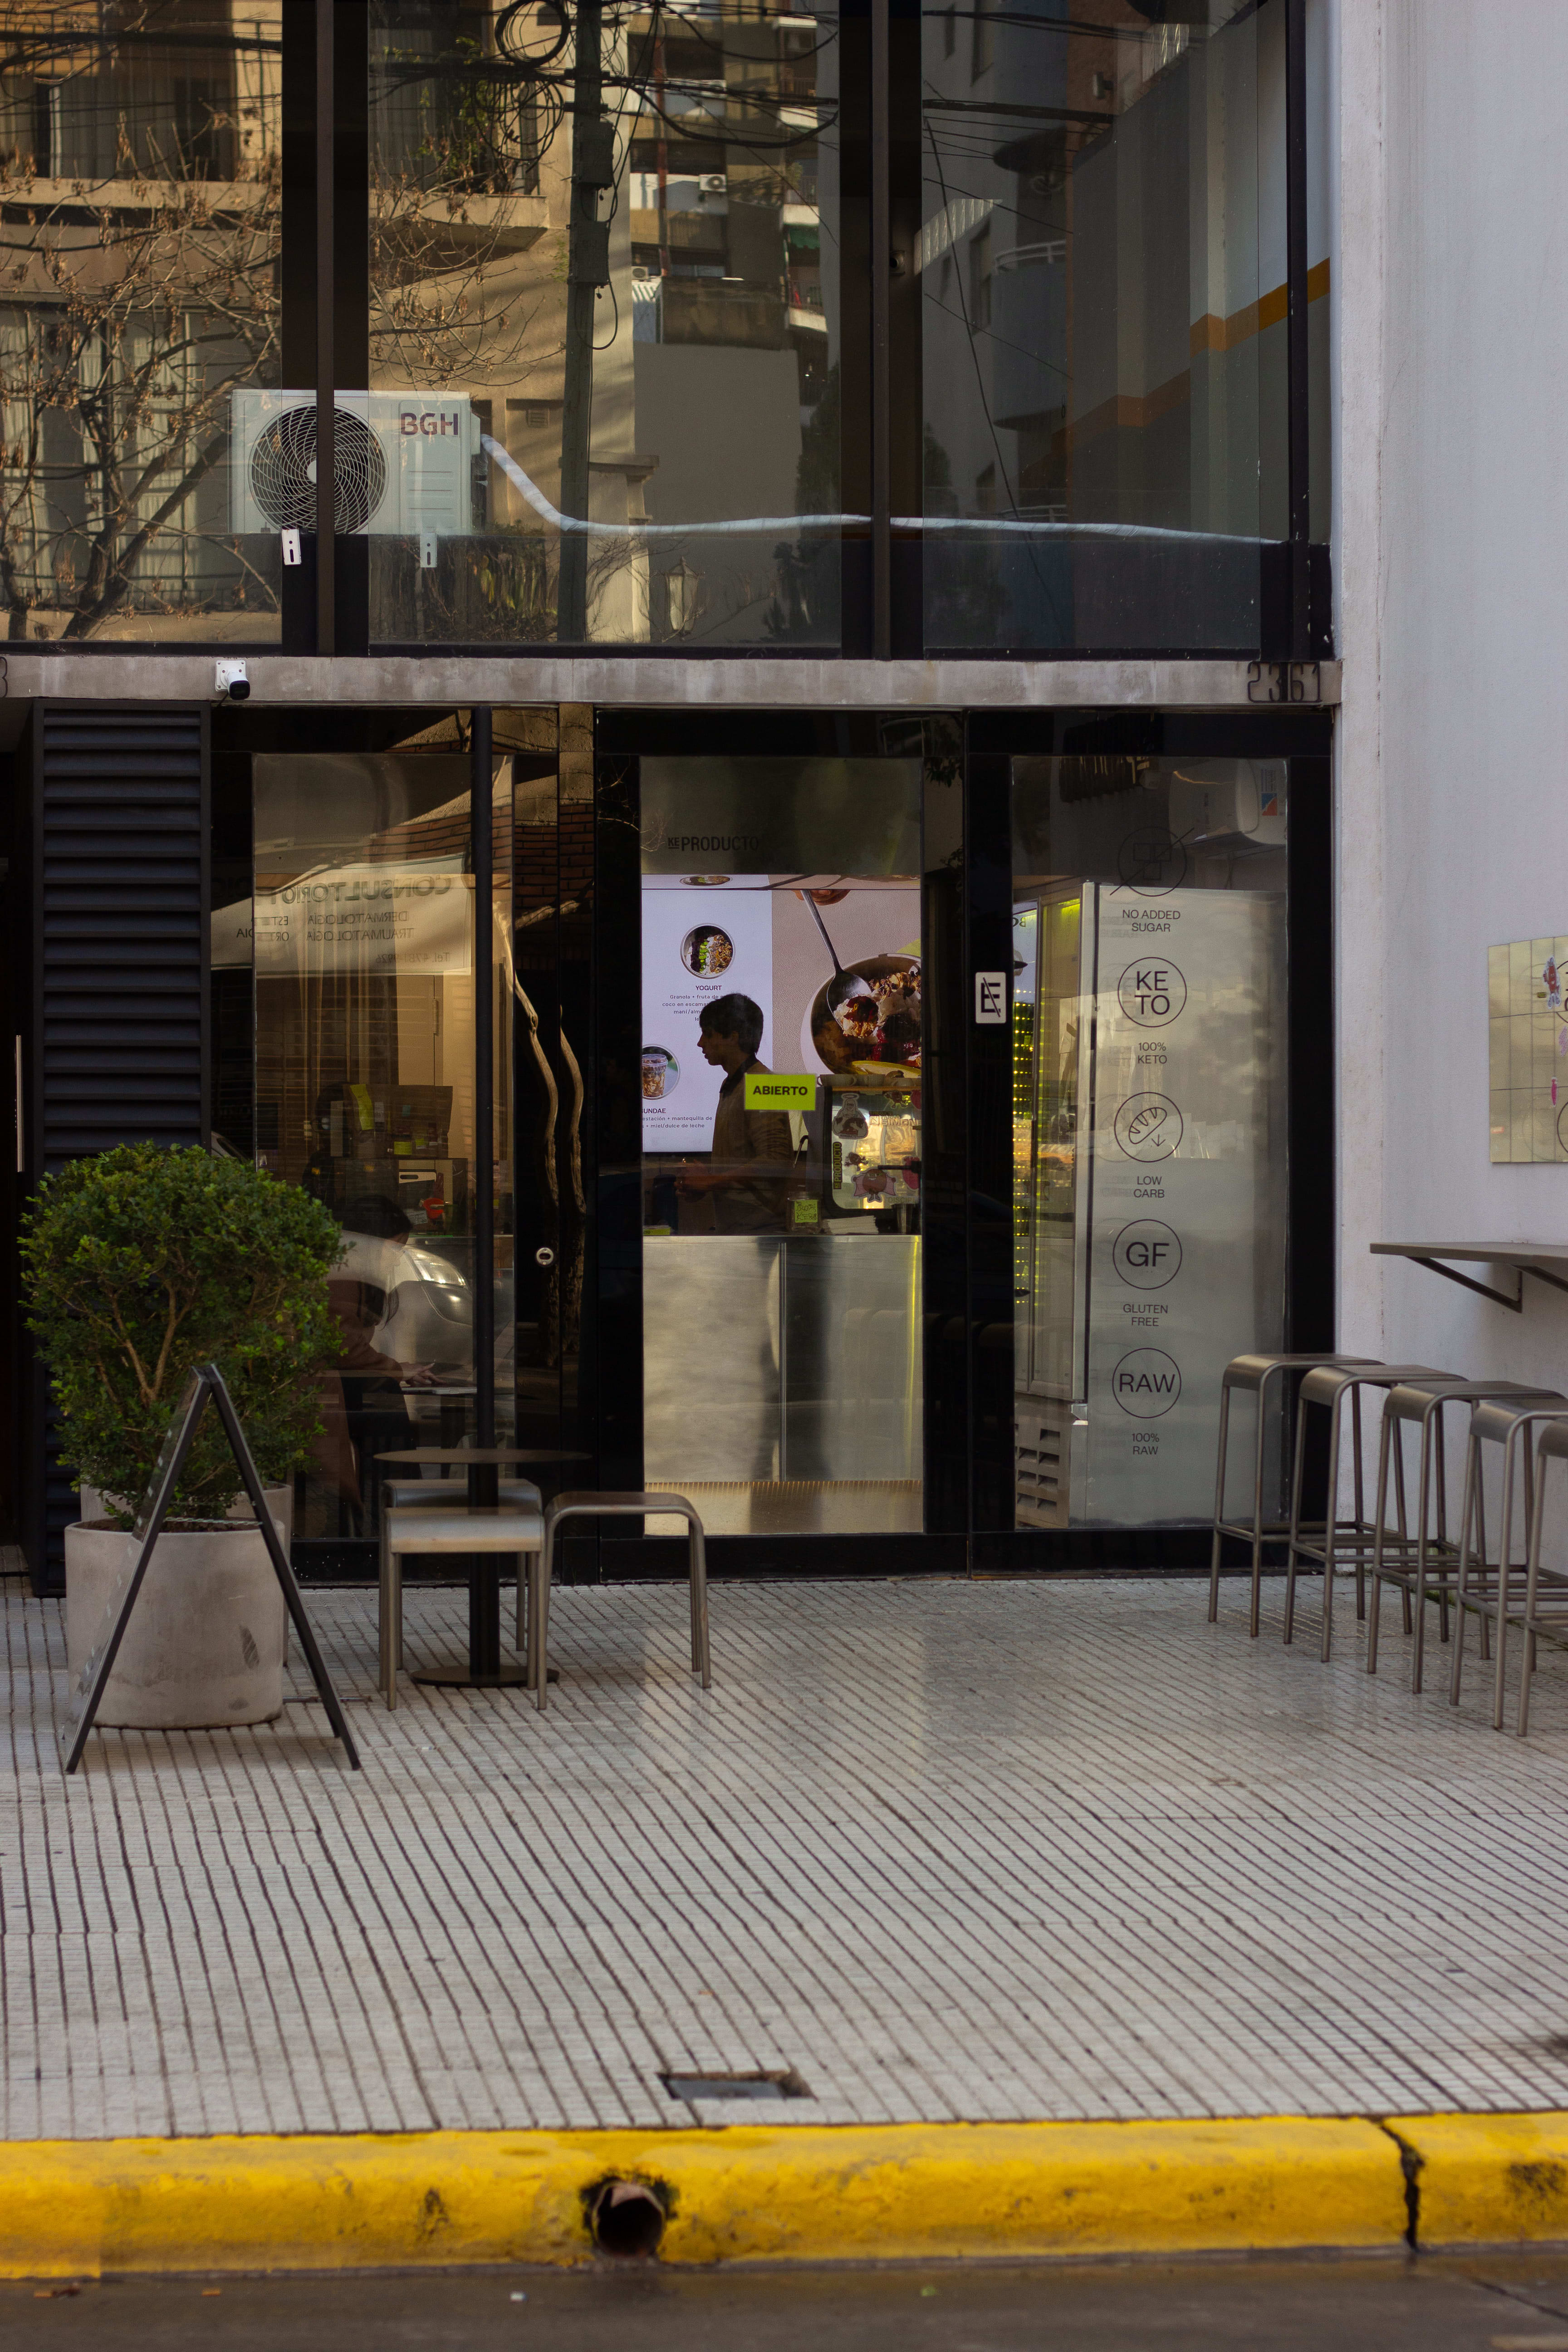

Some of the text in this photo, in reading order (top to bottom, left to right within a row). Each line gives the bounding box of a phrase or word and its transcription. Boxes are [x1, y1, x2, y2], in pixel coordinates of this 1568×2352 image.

[401, 412, 458, 436] BGH
[668, 836, 759, 851] KE PRODUCTO
[1122, 909, 1181, 920] NO ADDED
[1132, 922, 1171, 932] SUGAR
[1137, 970, 1168, 991] KE
[1135, 995, 1170, 1015] TO
[1138, 1042, 1166, 1052] 100%
[1137, 1055, 1167, 1065] KETO
[753, 1085, 808, 1096] ABIERTO
[1137, 1176, 1162, 1186] LOW
[1133, 1189, 1165, 1198] CARB
[1126, 1241, 1170, 1267] GF
[1123, 1303, 1168, 1314] GLUTEN
[1131, 1317, 1159, 1327] FREE
[1119, 1373, 1176, 1393] RAW
[1132, 1432, 1160, 1443] 100%
[1132, 1446, 1159, 1455] RAW
